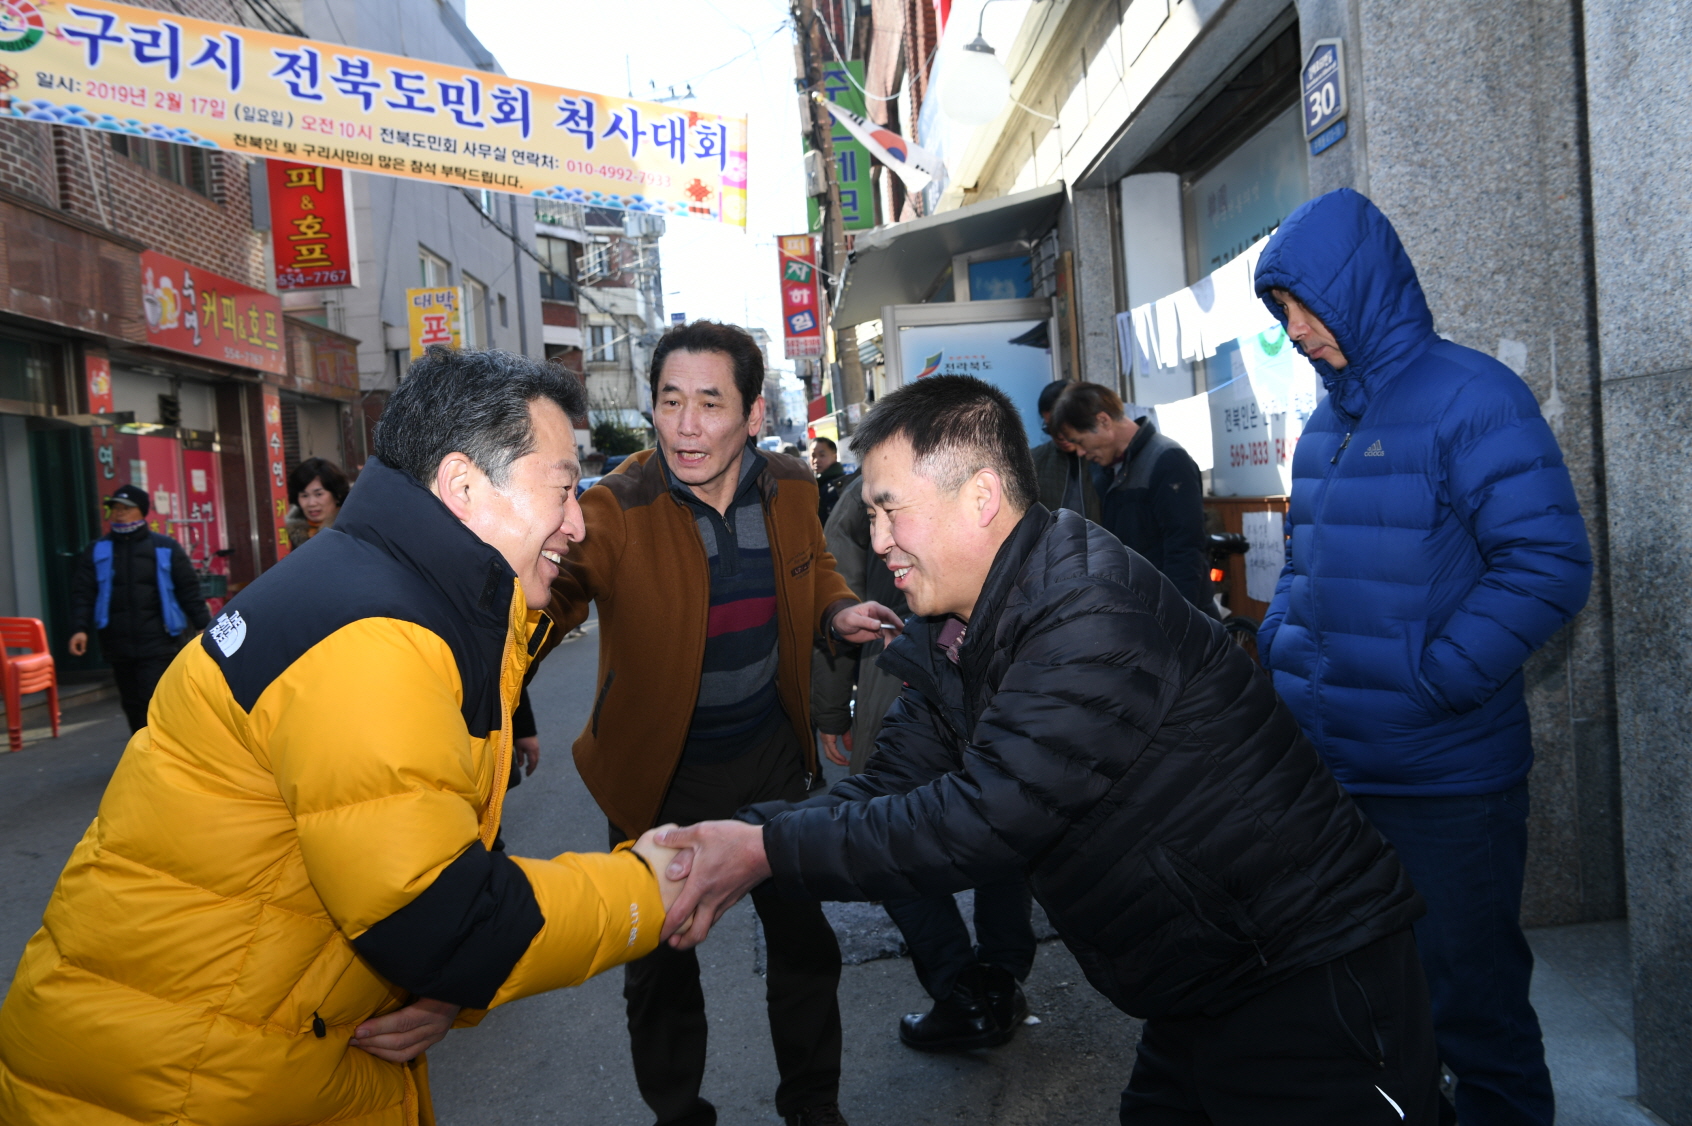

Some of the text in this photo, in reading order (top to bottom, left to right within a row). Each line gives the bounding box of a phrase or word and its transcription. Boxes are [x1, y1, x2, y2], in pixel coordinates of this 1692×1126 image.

[60, 5, 242, 91] 구리시
[271, 49, 531, 139] 전북도민회
[556, 98, 727, 171] 척사대회
[1309, 81, 1336, 127] 30
[36, 71, 82, 92] 일시:
[86, 81, 146, 108] 2019년
[154, 91, 182, 112] 2월
[191, 98, 225, 119] 17일
[301, 115, 333, 135] 오전
[339, 122, 373, 140] 10시
[380, 127, 457, 154] 전북도민회
[463, 141, 507, 161] 사무실
[511, 149, 560, 170] 연락처:
[566, 159, 672, 188] 010-4992-7933
[233, 133, 524, 189] 전북인 및 구리시민의 많은 참석 부탁드립니다.
[277, 270, 347, 287] 554-7767
[414, 291, 456, 312] 대박
[783, 239, 814, 332] 피자하임
[945, 361, 992, 373] 전라북도
[1225, 402, 1259, 432] 전북인은
[269, 432, 285, 487] 수연
[1230, 440, 1270, 468] 569-1833
